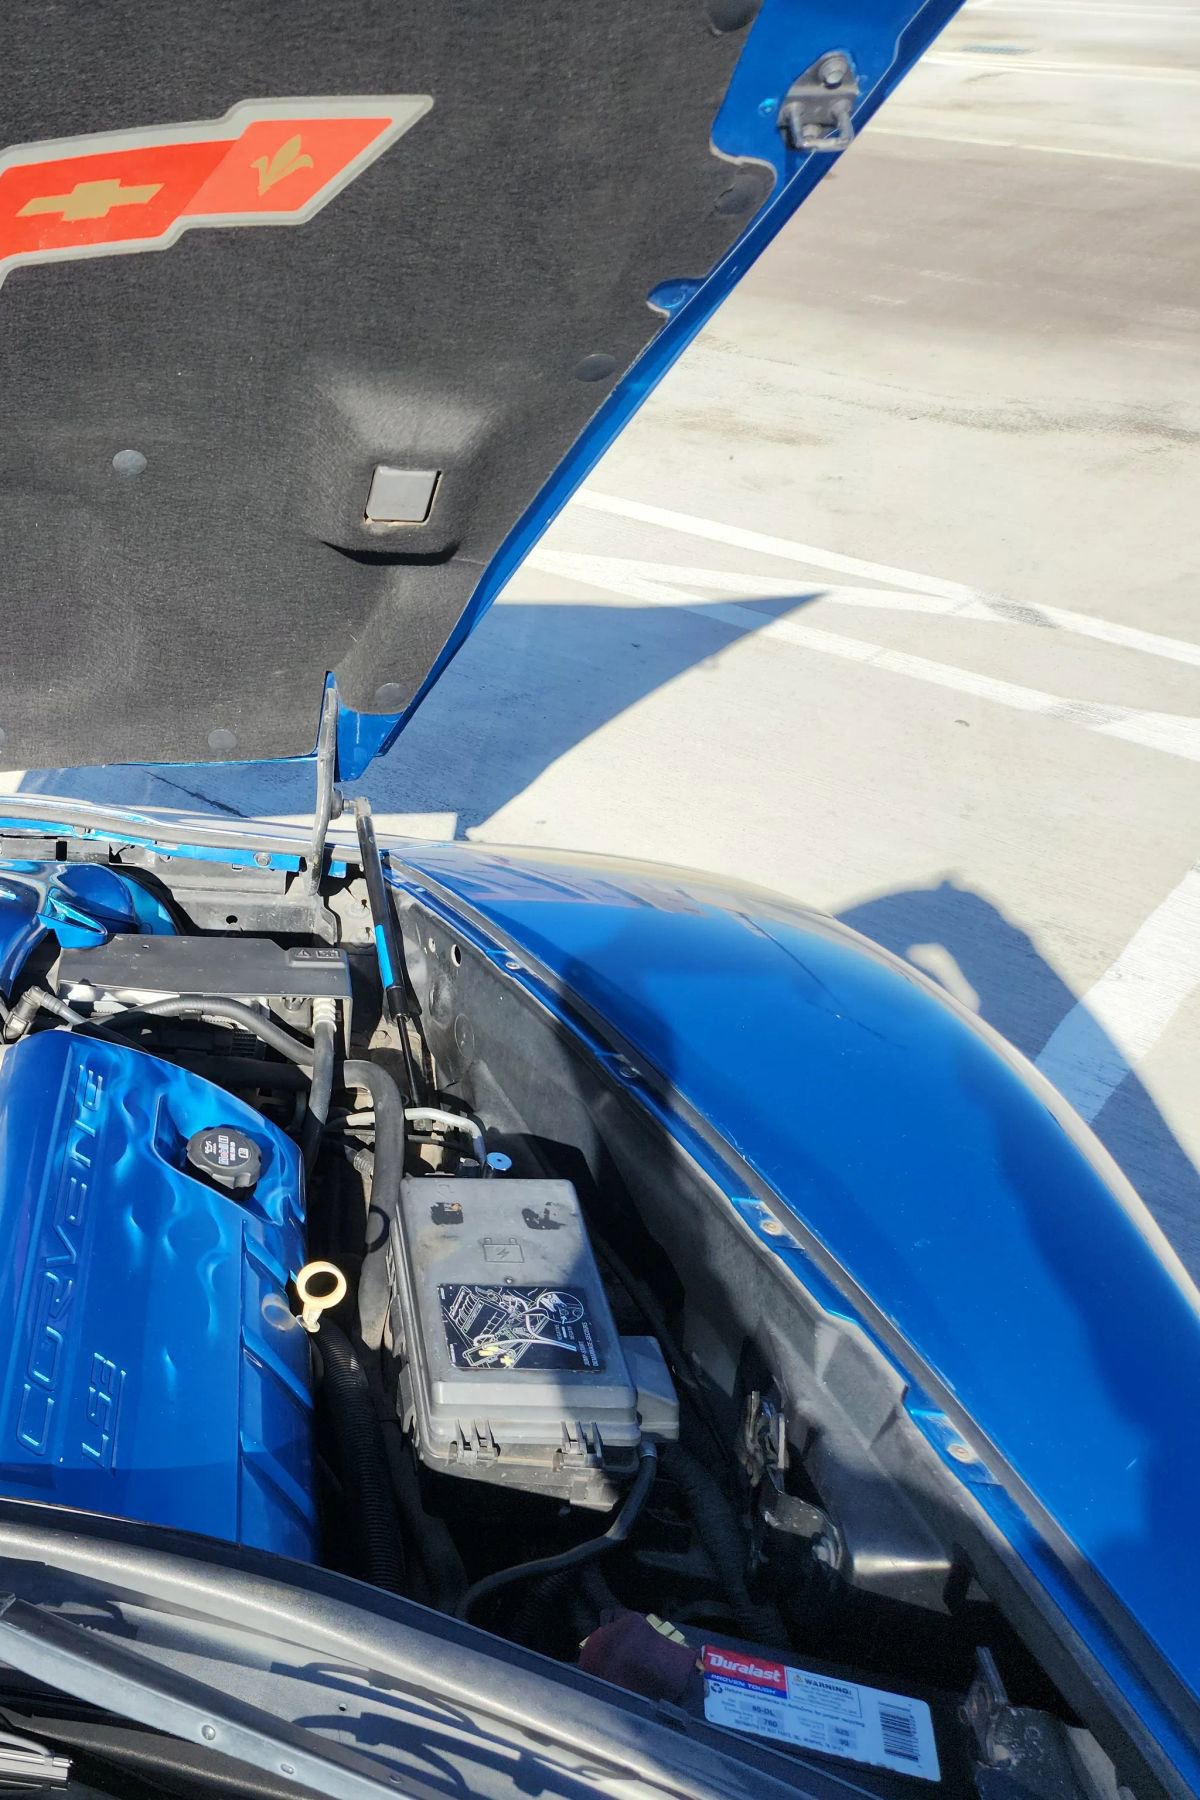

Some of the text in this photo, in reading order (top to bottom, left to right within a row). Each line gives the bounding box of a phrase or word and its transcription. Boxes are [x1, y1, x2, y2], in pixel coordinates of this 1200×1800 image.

[16, 1064, 103, 1456] CORVETTE
[81, 1352, 118, 1470] LS3
[707, 1652, 781, 1682] Duralast
[711, 1673, 776, 1695] PROVEN TOUGH
